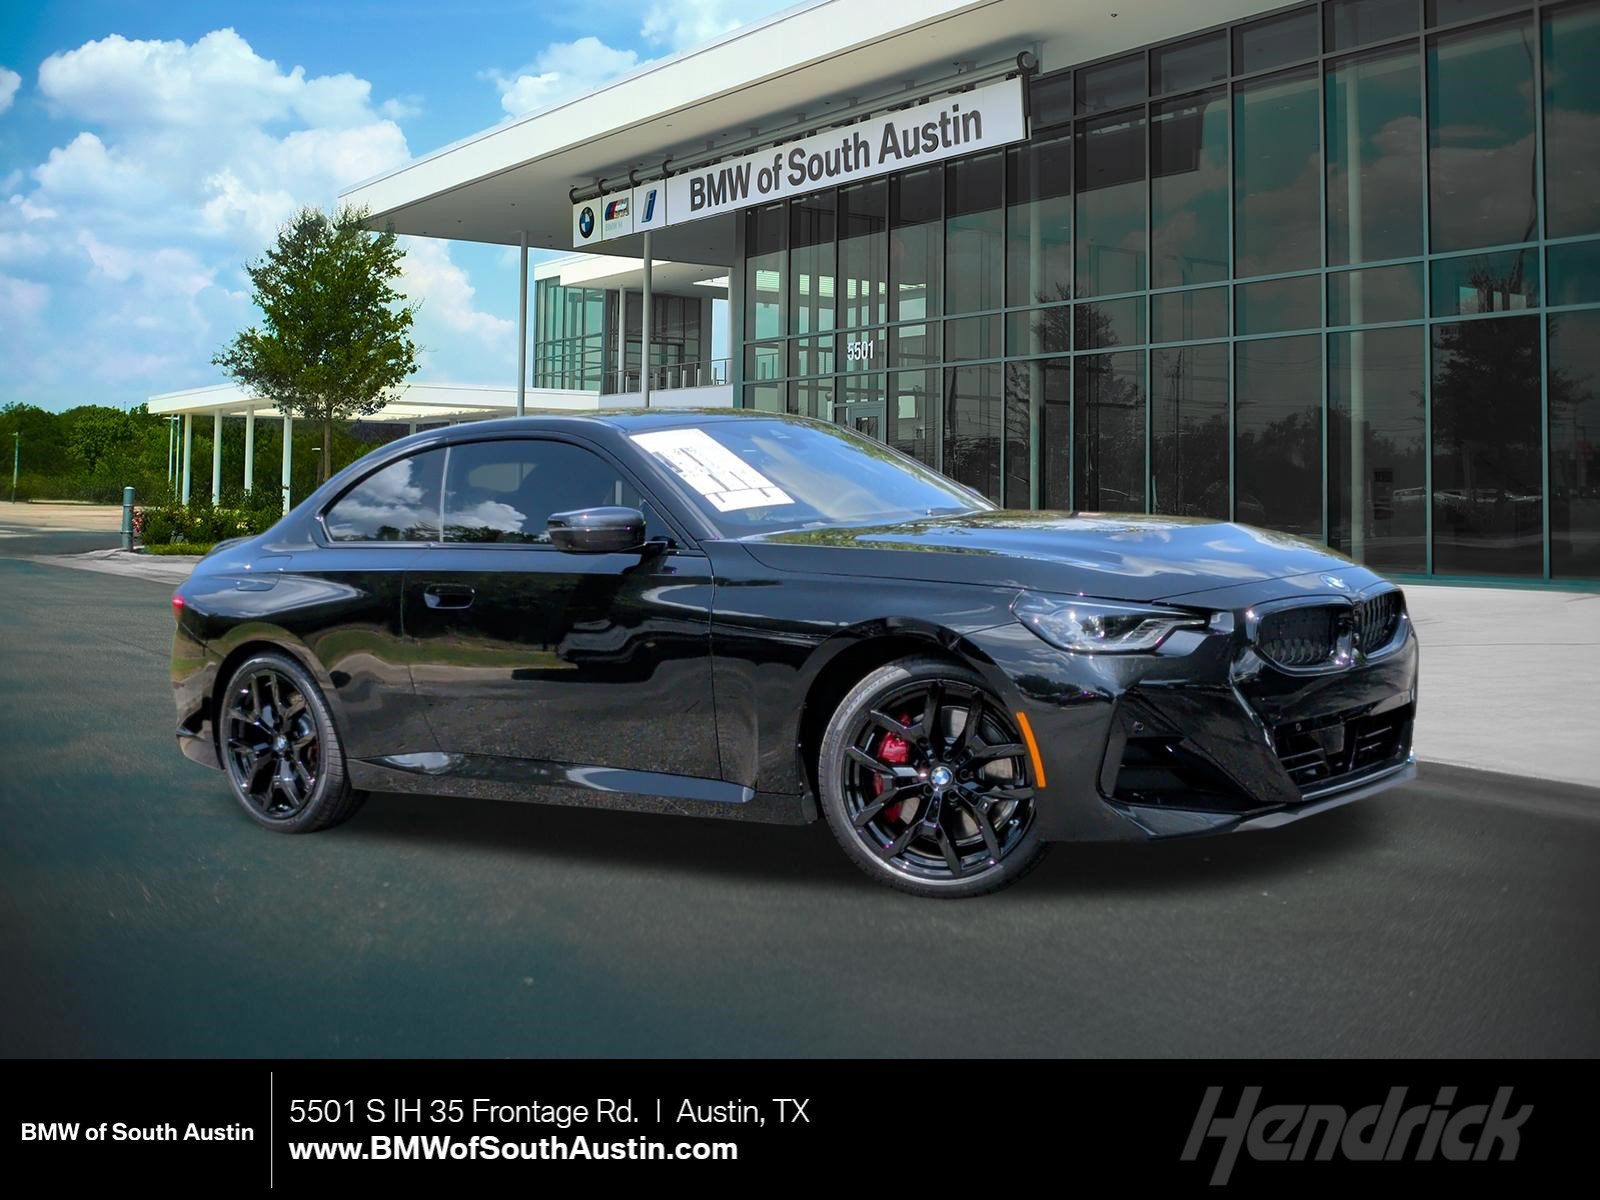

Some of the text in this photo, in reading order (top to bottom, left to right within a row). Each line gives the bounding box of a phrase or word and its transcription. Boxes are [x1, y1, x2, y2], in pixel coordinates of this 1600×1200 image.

[690, 162, 752, 212] BMW
[757, 153, 783, 194] of
[787, 131, 871, 186] South
[878, 103, 983, 165] Austin
[847, 340, 874, 361] 5501
